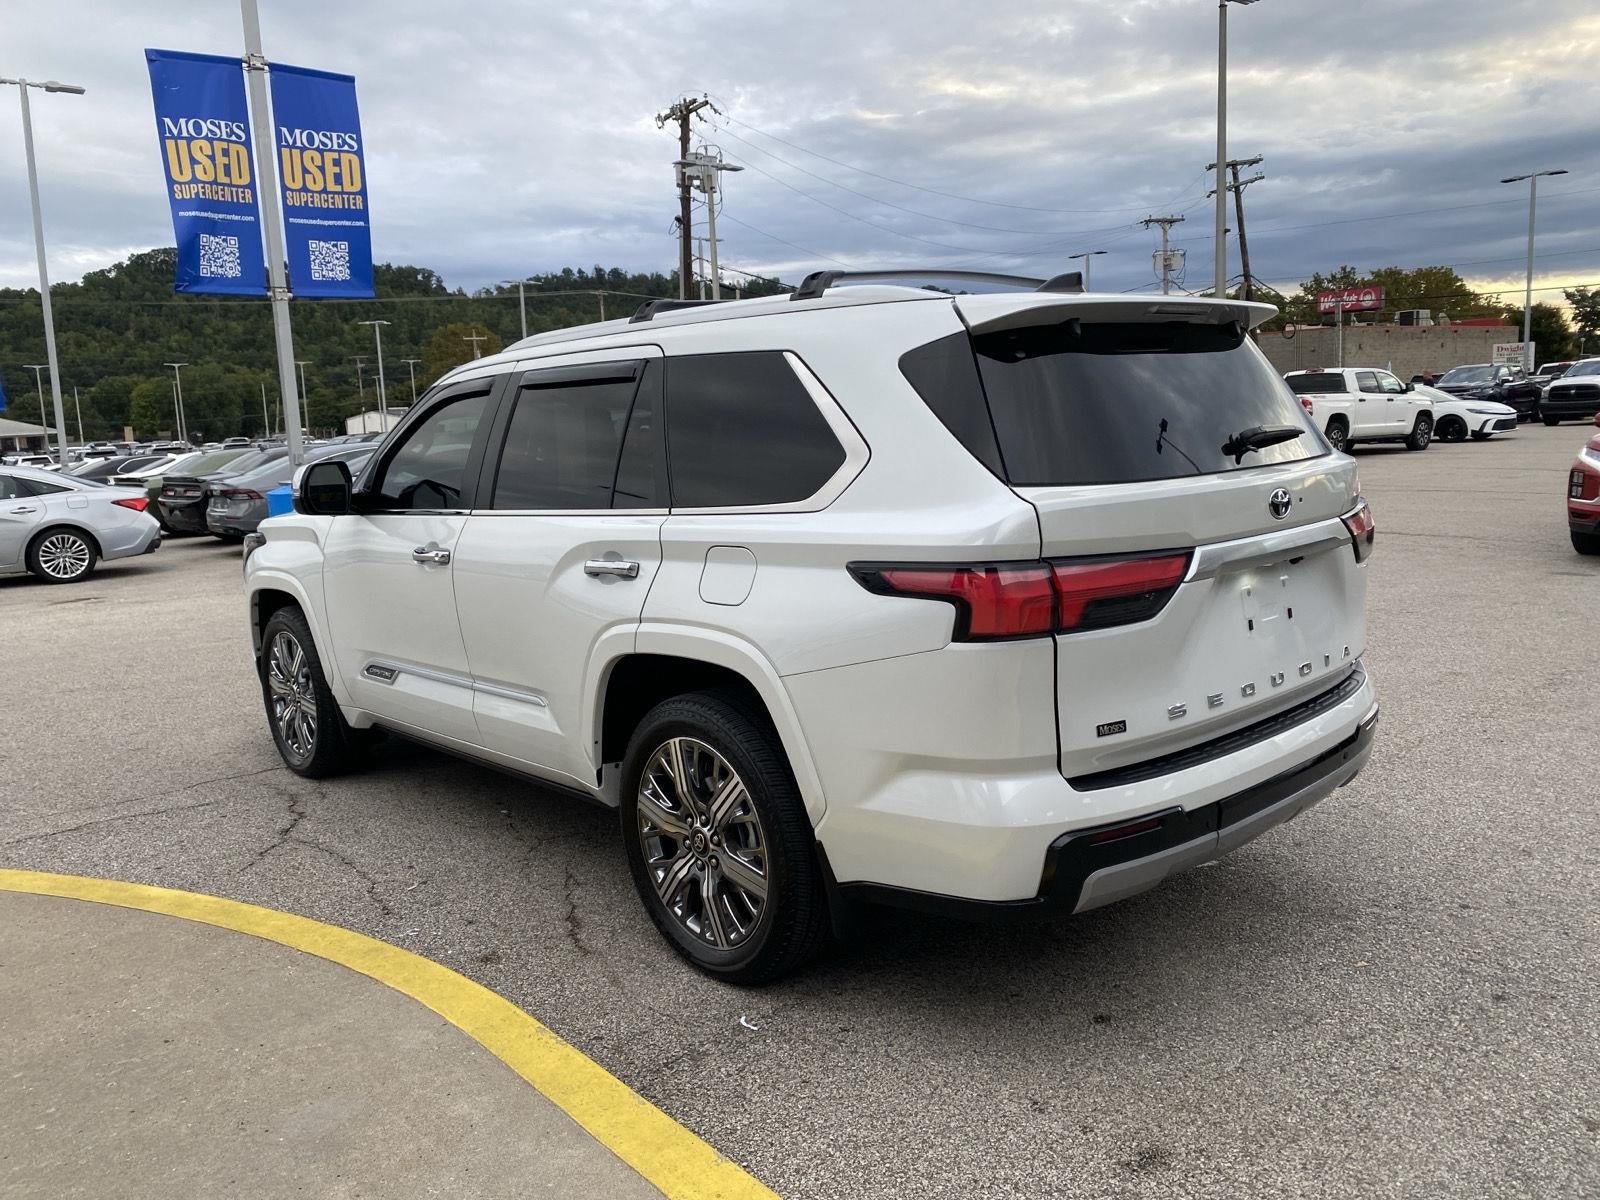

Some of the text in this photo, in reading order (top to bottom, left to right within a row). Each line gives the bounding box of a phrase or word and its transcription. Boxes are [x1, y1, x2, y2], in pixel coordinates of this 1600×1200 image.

[162, 117, 246, 141] MOSES
[279, 127, 358, 151] MOSES
[165, 139, 250, 186] USED
[281, 148, 362, 192] USED
[173, 183, 253, 204] SUPERCENTER
[286, 190, 363, 210] SUPERCENTER
[178, 210, 255, 222] mosesusedsupercenter.com
[288, 217, 365, 227] mosesusedsupercenter.com
[1167, 645, 1350, 720] SEQUOIA
